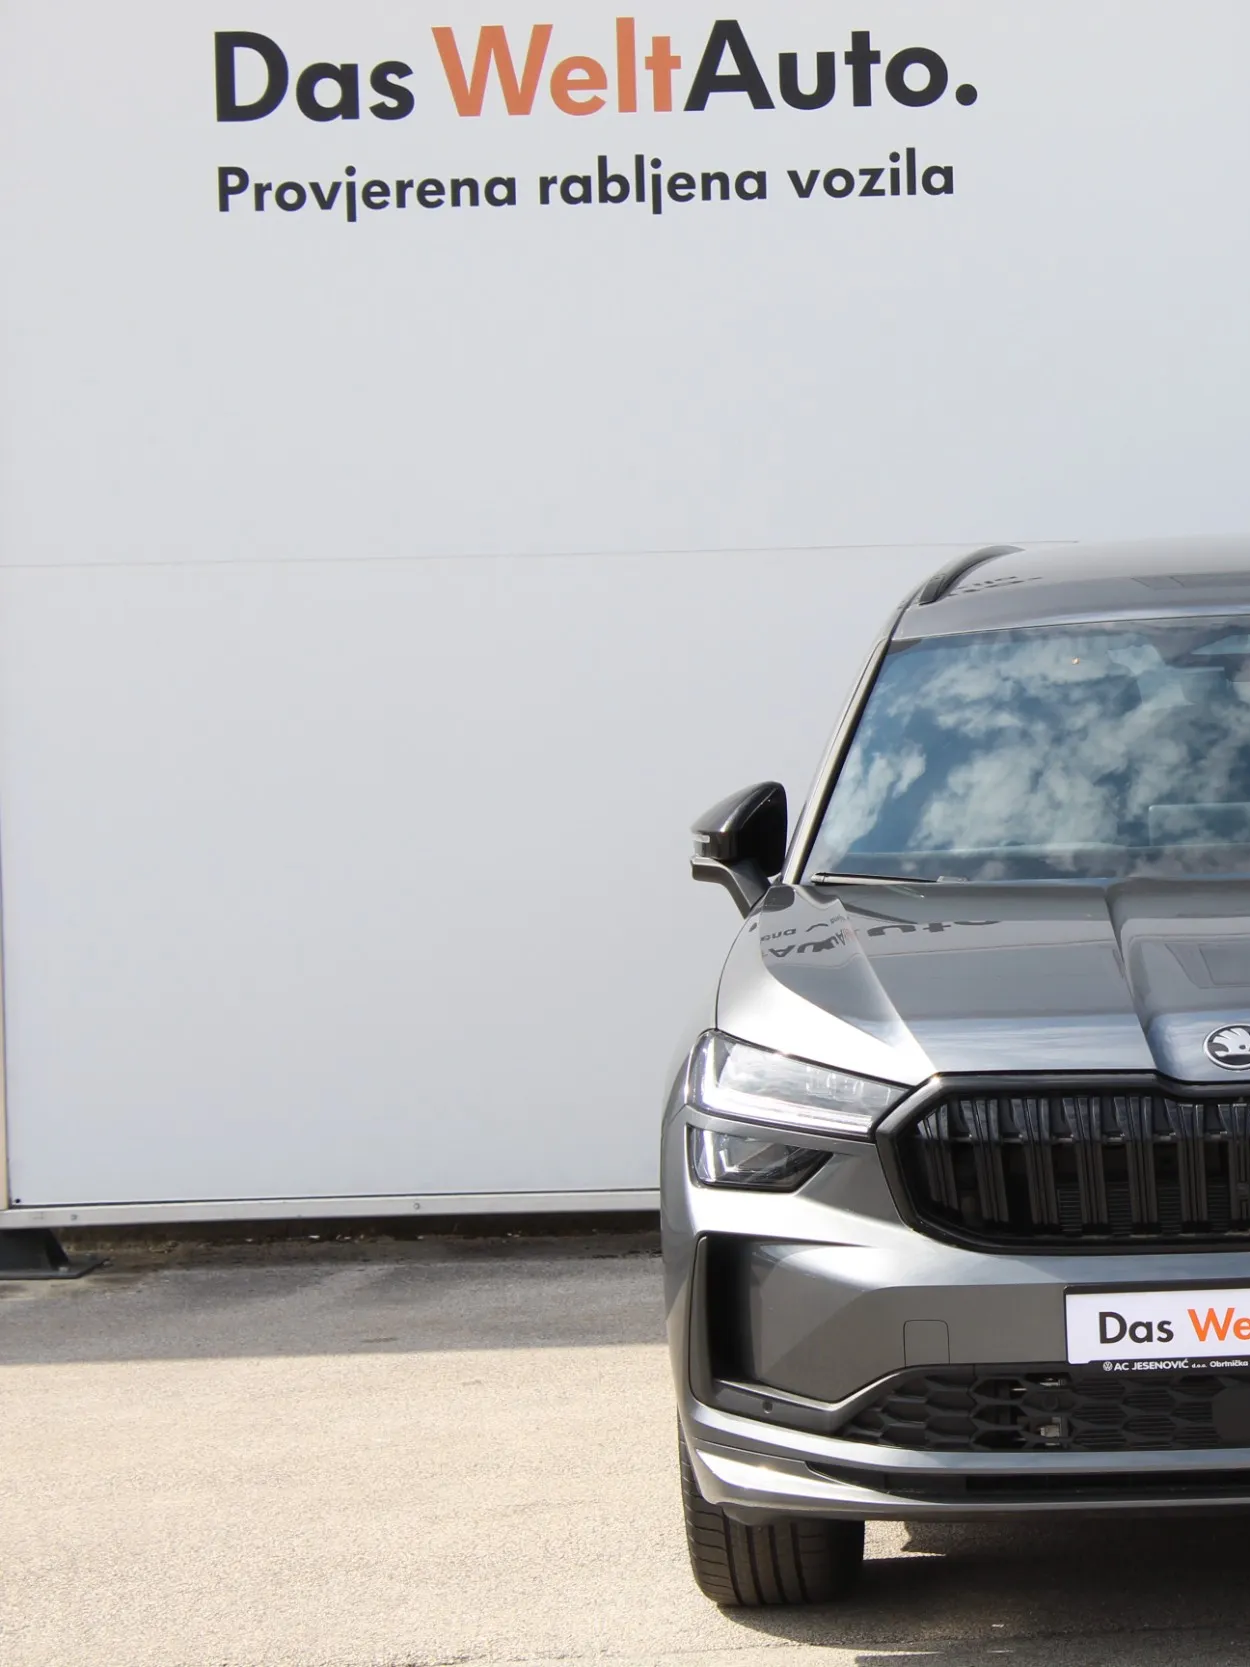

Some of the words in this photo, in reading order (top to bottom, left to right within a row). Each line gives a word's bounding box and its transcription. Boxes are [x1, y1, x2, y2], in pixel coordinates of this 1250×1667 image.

[214, 30, 415, 123] Das
[432, 16, 978, 117] WeltAuto.
[217, 165, 518, 223] Provjerena
[539, 154, 767, 215] rabljena
[786, 146, 954, 199] vozila
[1098, 1311, 1175, 1345] Das
[1113, 1361, 1130, 1372] AC
[1131, 1357, 1190, 1371] JESENOVIĆ
[1209, 1359, 1249, 1369] Obrtnička
